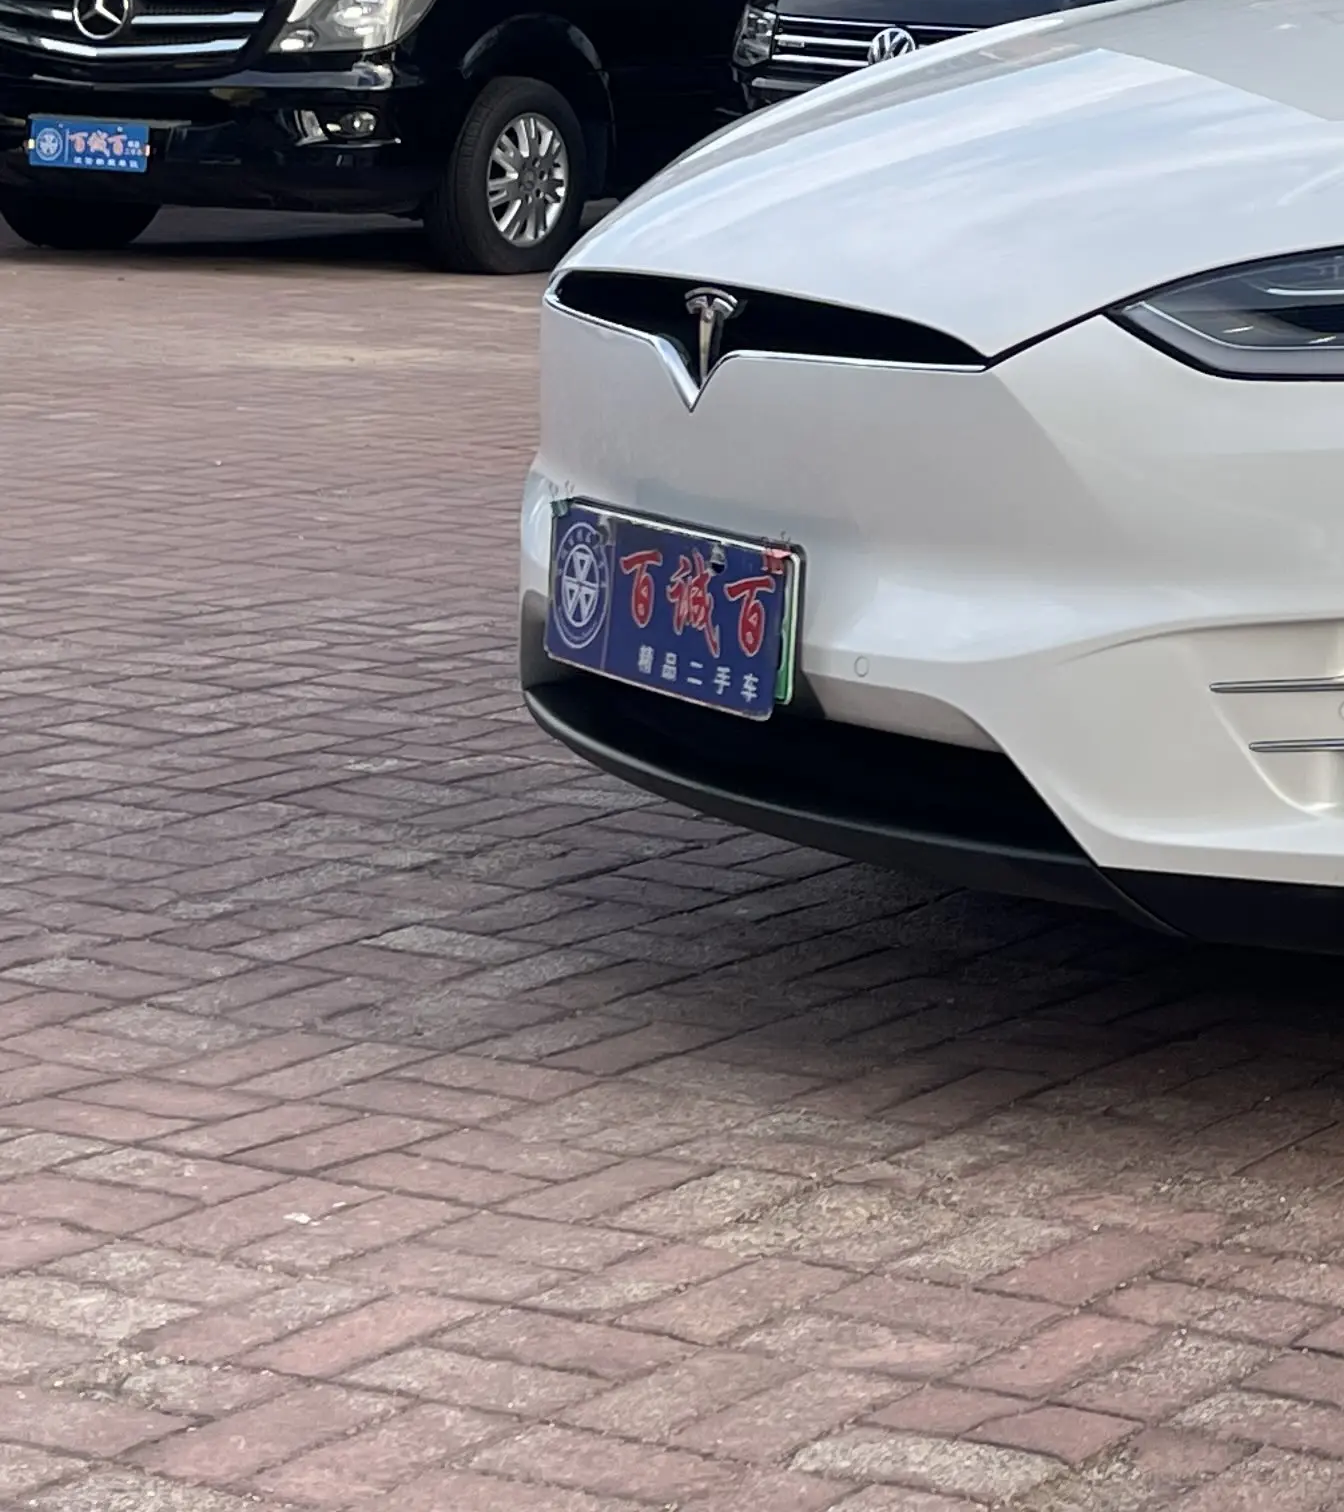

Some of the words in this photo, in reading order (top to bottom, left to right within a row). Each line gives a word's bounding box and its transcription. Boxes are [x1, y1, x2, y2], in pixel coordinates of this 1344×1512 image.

[637, 644, 759, 703] 精品二手车
